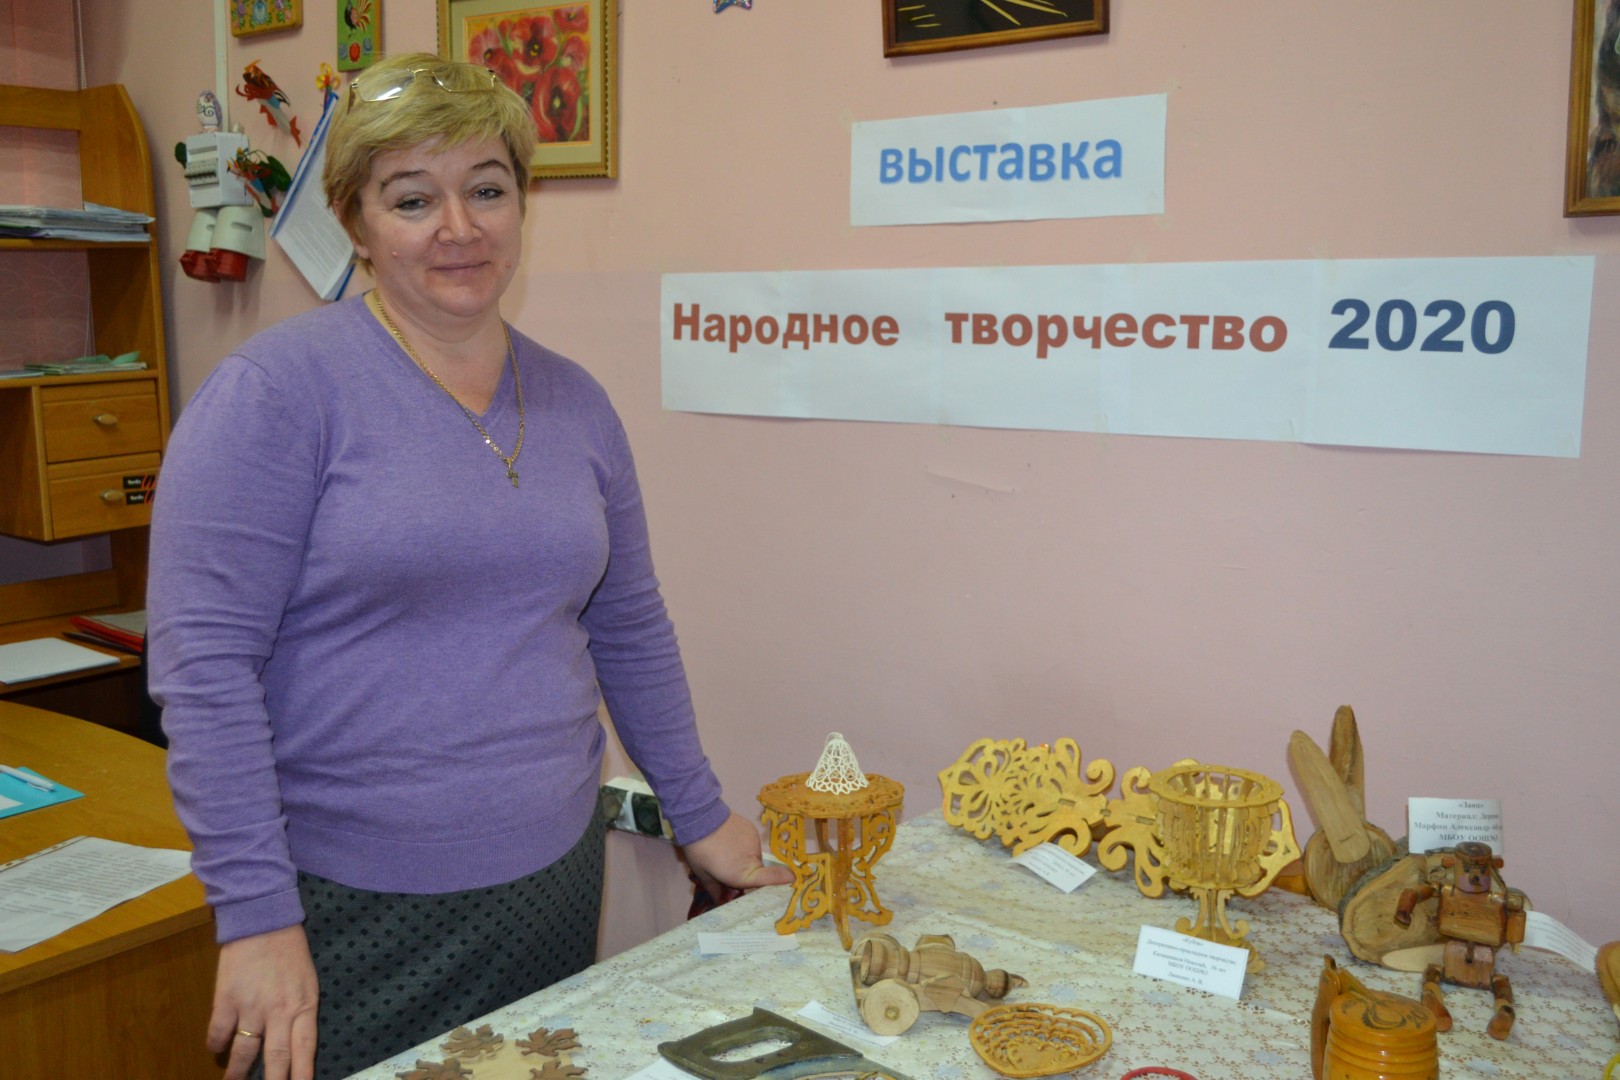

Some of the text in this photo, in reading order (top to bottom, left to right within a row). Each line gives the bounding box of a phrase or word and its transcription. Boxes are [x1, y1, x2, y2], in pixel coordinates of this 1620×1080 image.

[880, 138, 1123, 185] выставка
[672, 298, 1517, 360] Народное творчество 2020
